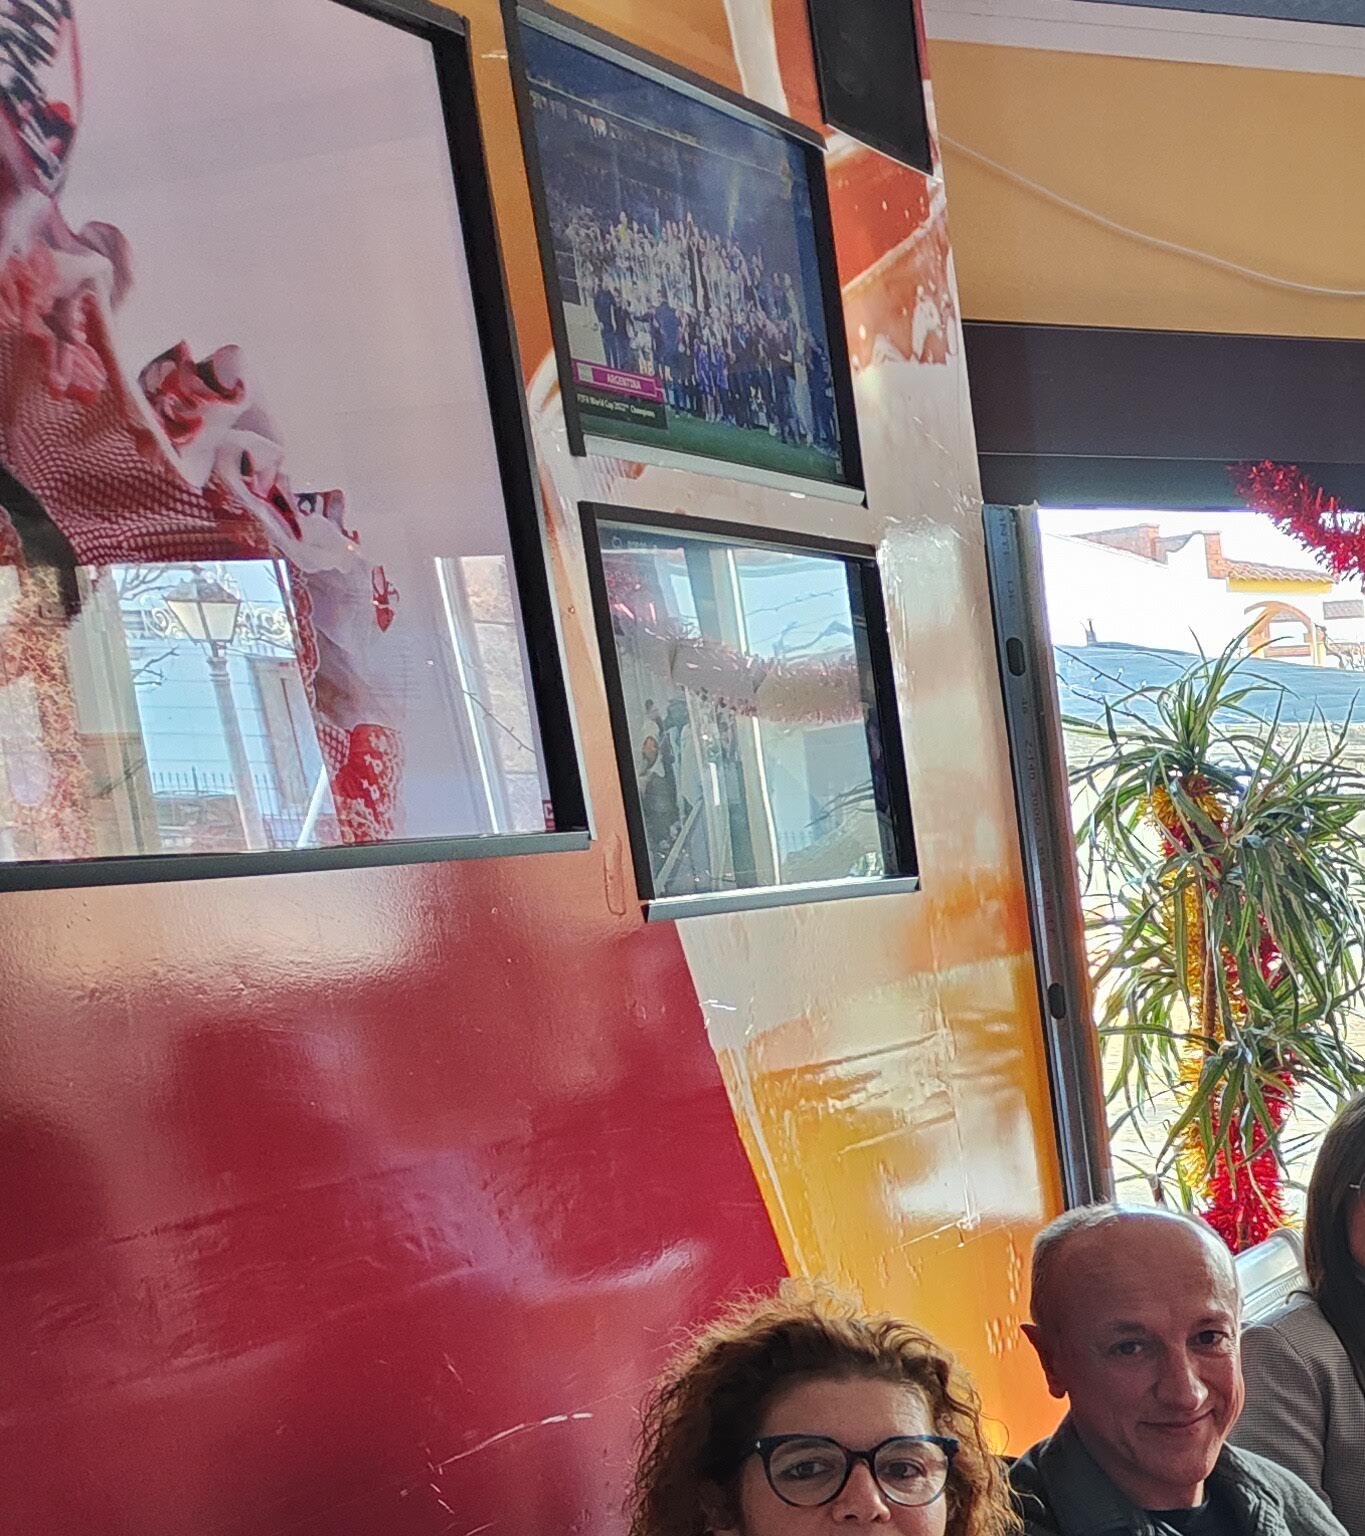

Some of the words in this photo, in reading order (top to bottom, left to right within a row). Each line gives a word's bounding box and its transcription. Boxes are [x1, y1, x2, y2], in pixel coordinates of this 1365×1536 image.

[607, 373, 641, 390] ARGENTINA
[576, 393, 589, 403] FIFA
[590, 396, 605, 408] World
[630, 404, 656, 419] Champions
